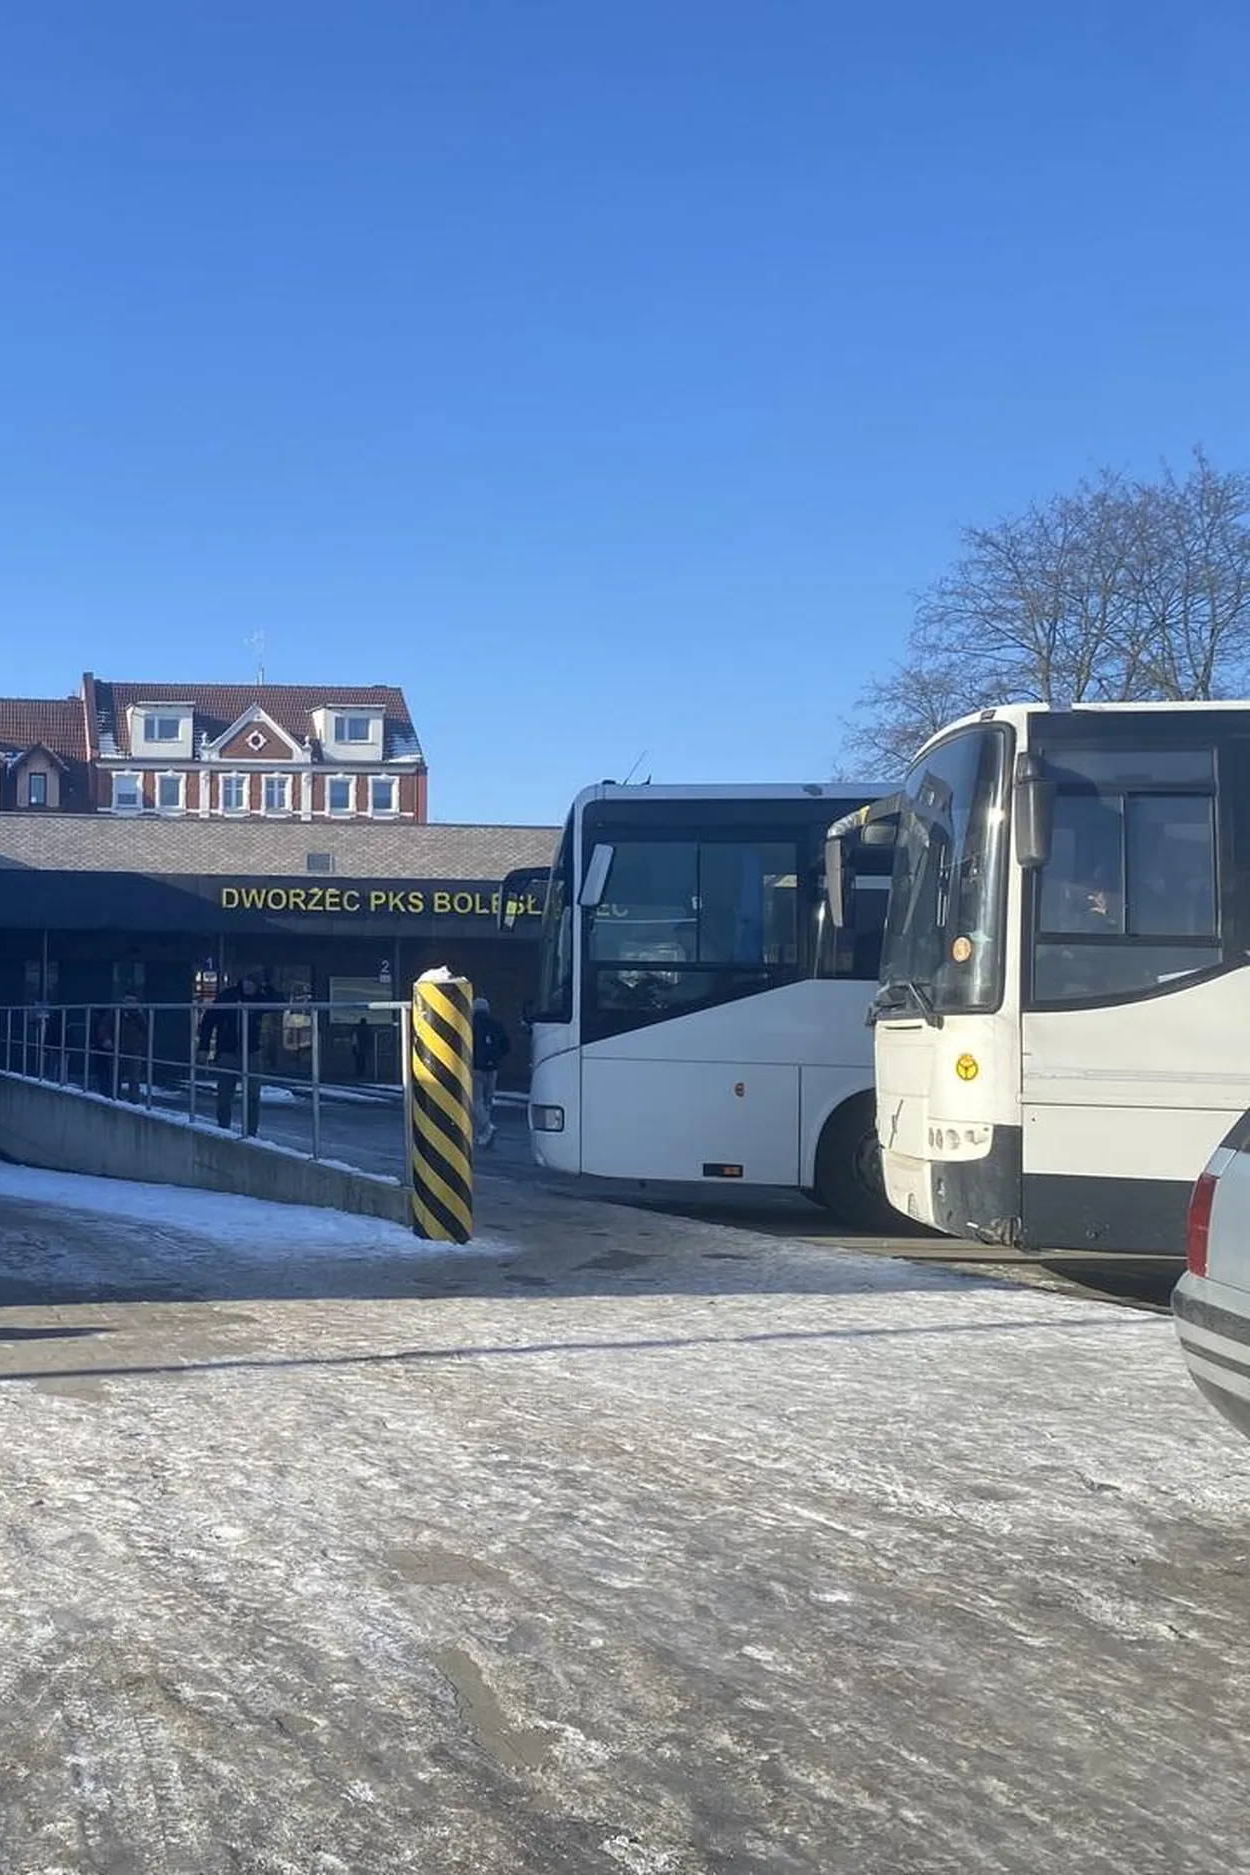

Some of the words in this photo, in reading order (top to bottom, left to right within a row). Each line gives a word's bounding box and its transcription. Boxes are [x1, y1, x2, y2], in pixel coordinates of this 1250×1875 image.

[221, 888, 360, 912] DWORZEC
[369, 891, 424, 913] PKS
[381, 959, 390, 973] 2
